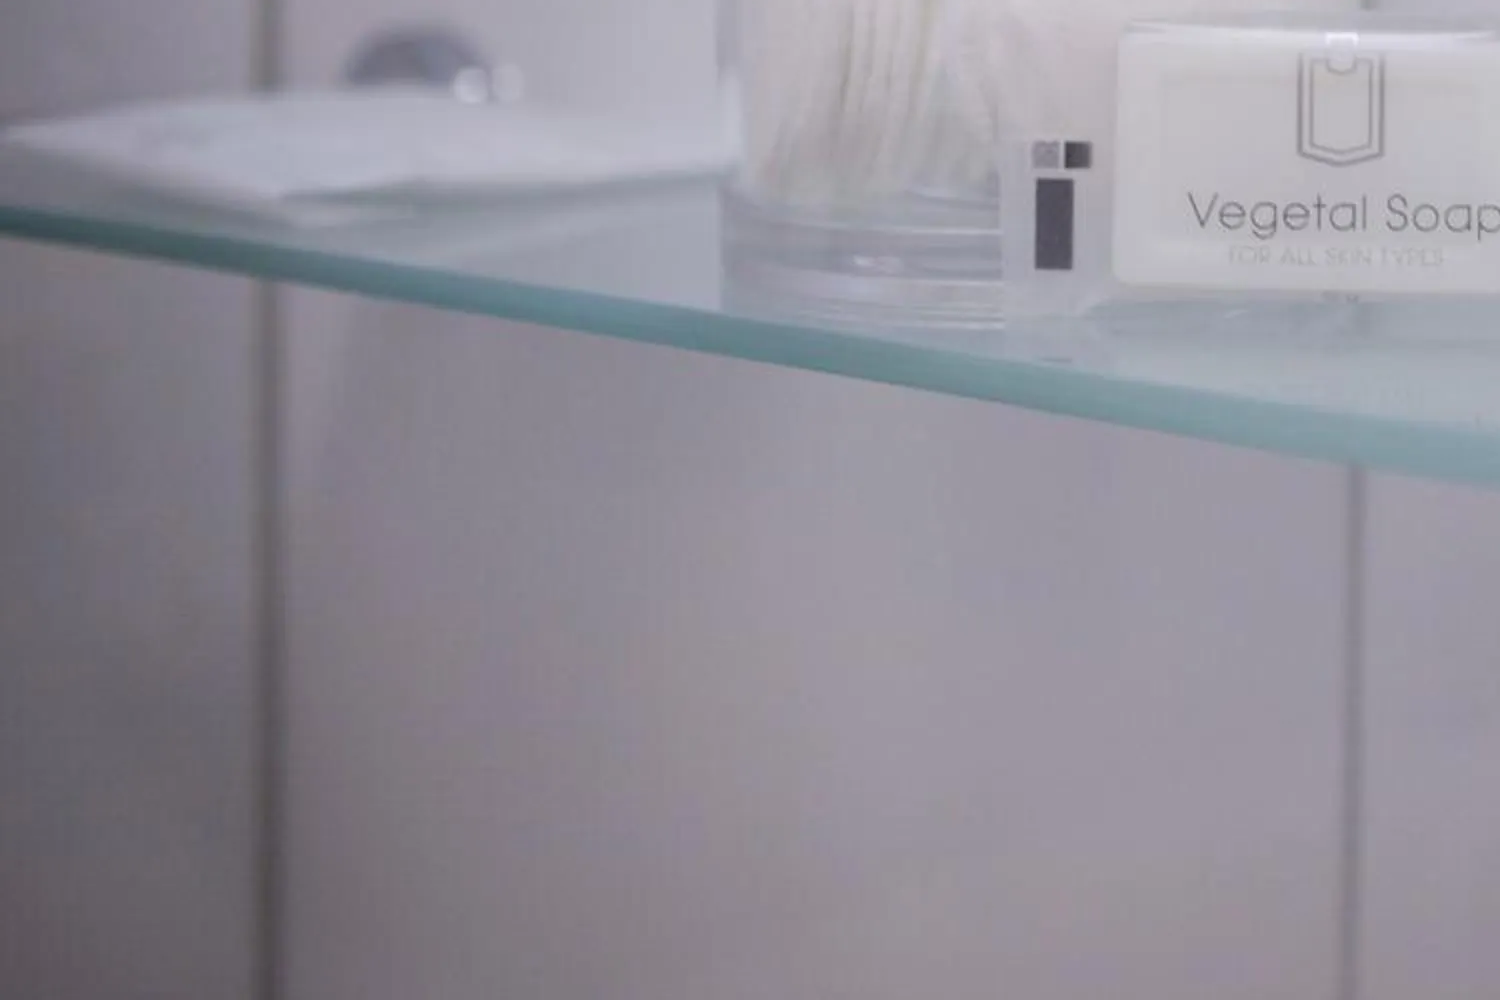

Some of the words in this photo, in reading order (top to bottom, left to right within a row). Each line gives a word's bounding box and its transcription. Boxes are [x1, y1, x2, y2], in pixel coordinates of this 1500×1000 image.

[1186, 191, 1368, 240] Vegetal
[1279, 245, 1318, 266] ALL
[1324, 245, 1374, 266] SKIN
